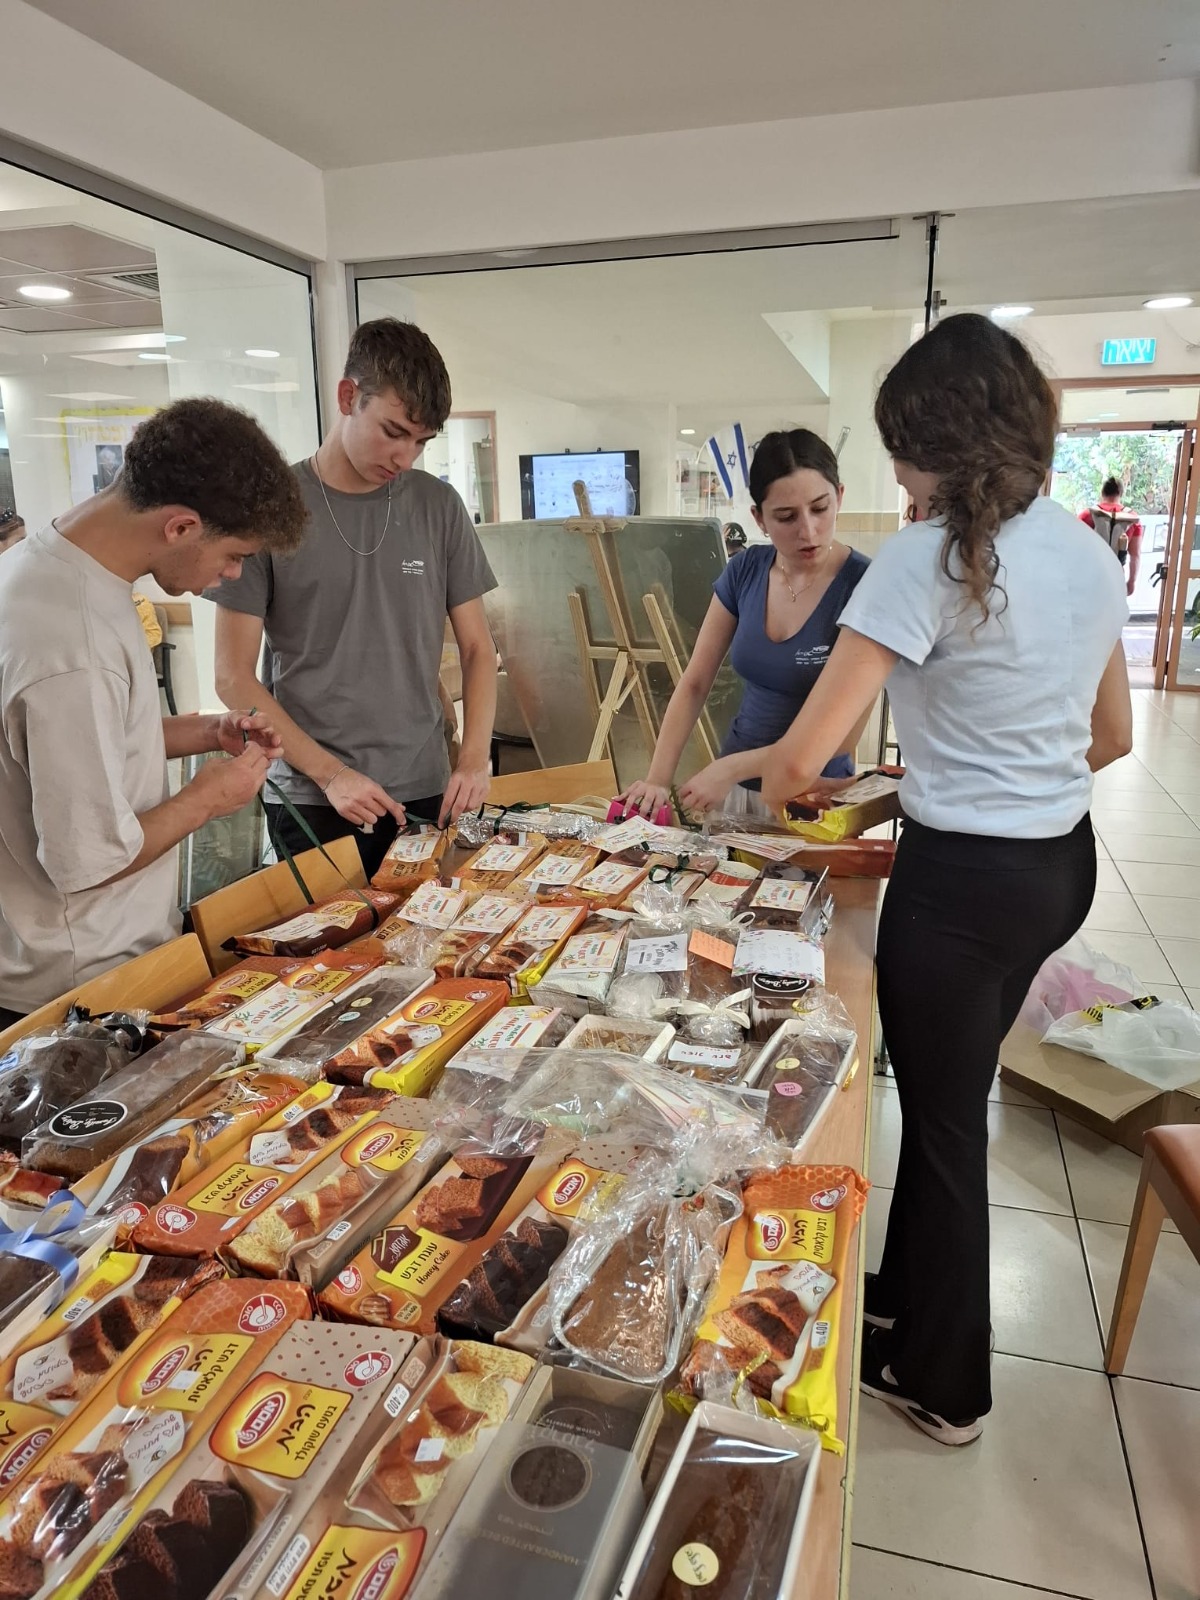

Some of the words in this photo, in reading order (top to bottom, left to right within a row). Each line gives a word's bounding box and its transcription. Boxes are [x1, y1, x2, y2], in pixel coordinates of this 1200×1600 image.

[1107, 339, 1152, 363] יציאה
[370, 1135, 391, 1154] אסם
[201, 1186, 221, 1204] דבש
[218, 1167, 246, 1192] קלאסית
[221, 1175, 254, 1202] הבית
[248, 1184, 268, 1203] אסם
[565, 1177, 582, 1198] אסם
[792, 1219, 808, 1250] הבית
[418, 1241, 438, 1261] עוגת
[400, 1260, 421, 1280] דבש
[416, 1265, 440, 1285] Honey
[434, 1249, 452, 1265] Cake
[158, 1353, 181, 1382] אסם
[213, 1342, 239, 1370] דבש
[187, 1364, 223, 1404] קלאסית
[253, 1399, 279, 1431] אסם
[276, 1403, 317, 1455] הבית
[315, 1405, 339, 1435] בטעם
[294, 1429, 321, 1462] שוקולד
[4, 1449, 37, 1481] אסם
[311, 1551, 334, 1577] תפוז
